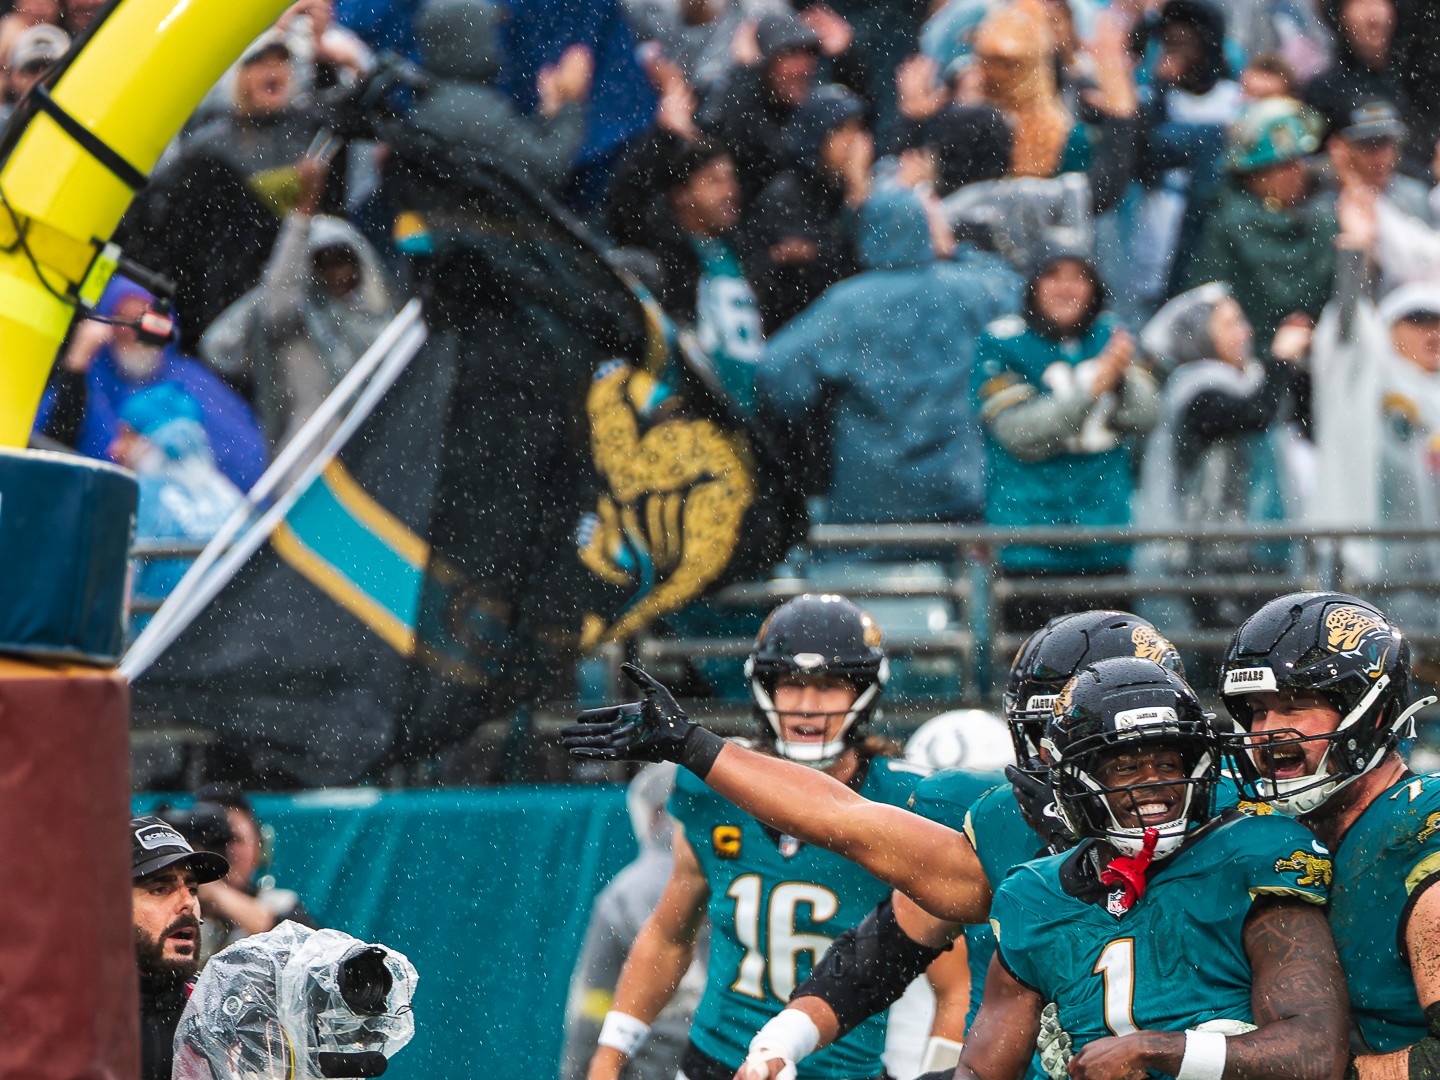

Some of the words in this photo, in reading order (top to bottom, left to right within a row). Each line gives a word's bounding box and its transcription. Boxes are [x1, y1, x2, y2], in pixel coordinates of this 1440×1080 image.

[1230, 670, 1264, 683] JAGUARS
[1031, 698, 1056, 710] JAGUA
[1136, 712, 1158, 720] JAGUARS
[712, 825, 742, 853] C
[726, 873, 839, 1004] 16
[1091, 936, 1141, 1037] 1
